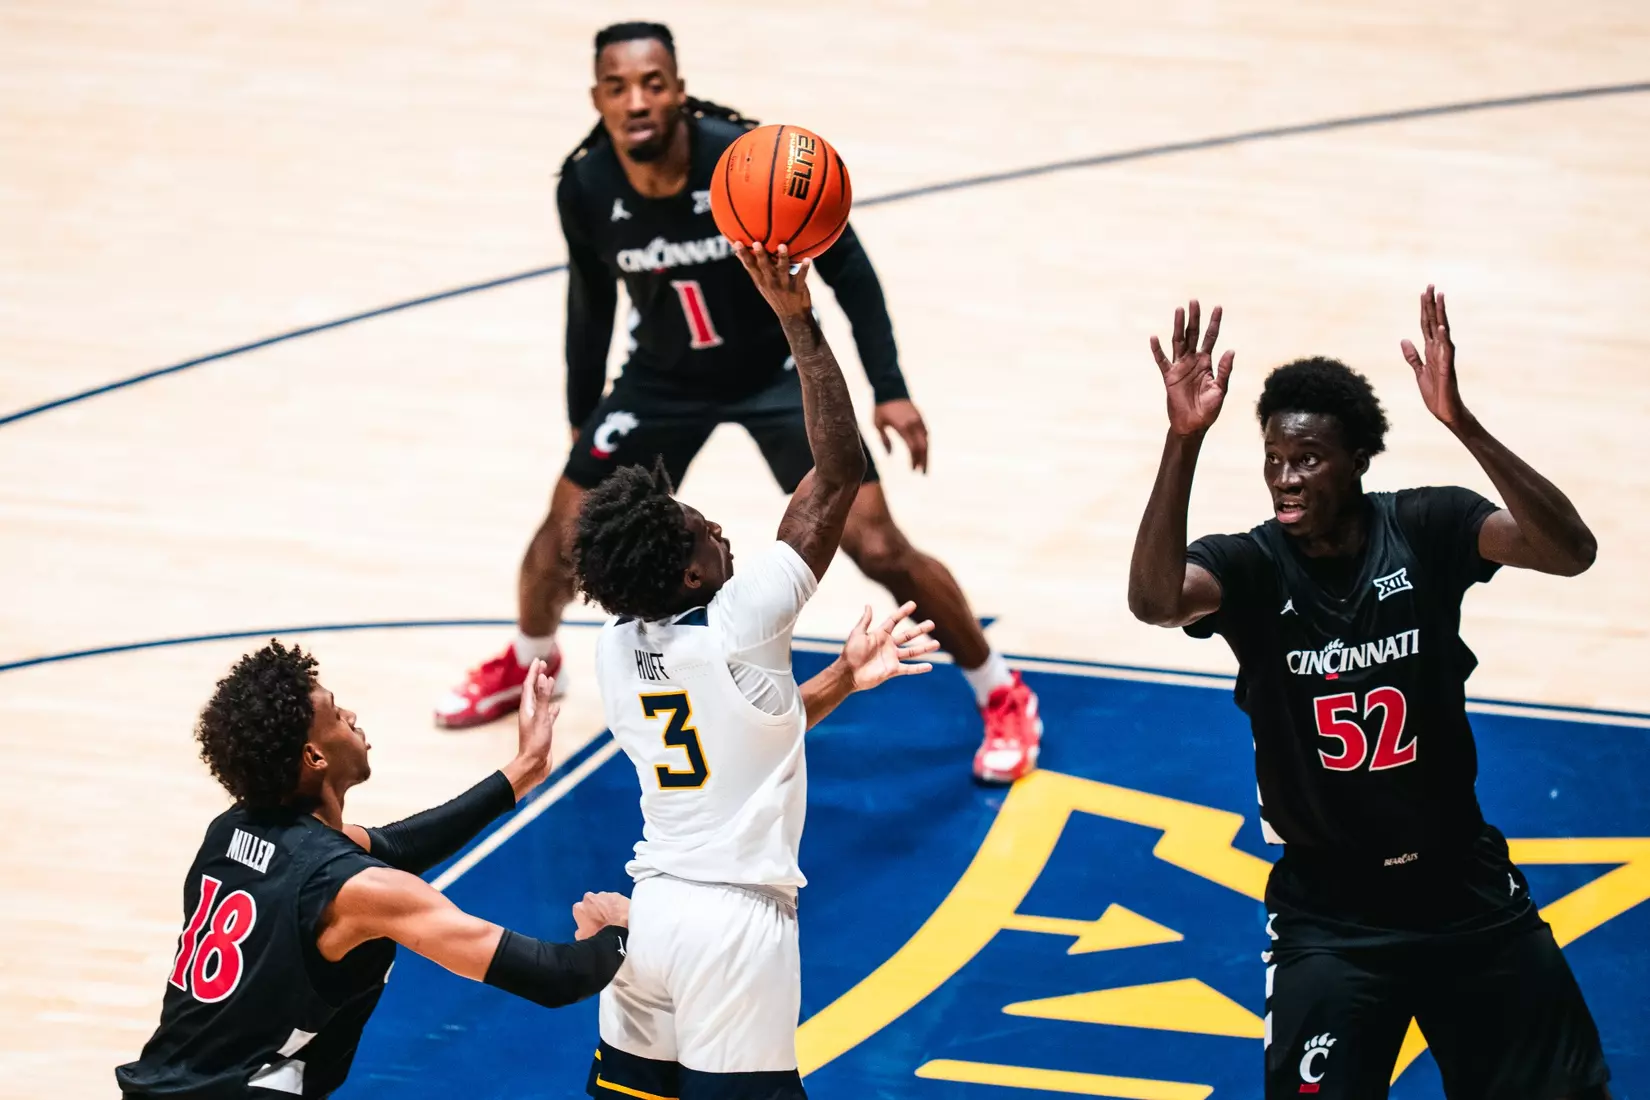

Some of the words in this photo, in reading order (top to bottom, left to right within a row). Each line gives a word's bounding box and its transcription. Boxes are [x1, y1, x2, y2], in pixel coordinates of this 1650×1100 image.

[787, 134, 816, 201] ELITE
[617, 235, 736, 273] CINCINNAT
[672, 280, 723, 349] 1
[635, 649, 670, 680] HUFF
[1286, 629, 1419, 676] CINCINNATI
[638, 690, 711, 790] 3
[1313, 686, 1417, 771] 52
[225, 827, 276, 874] MILLER
[169, 874, 256, 1003] 18
